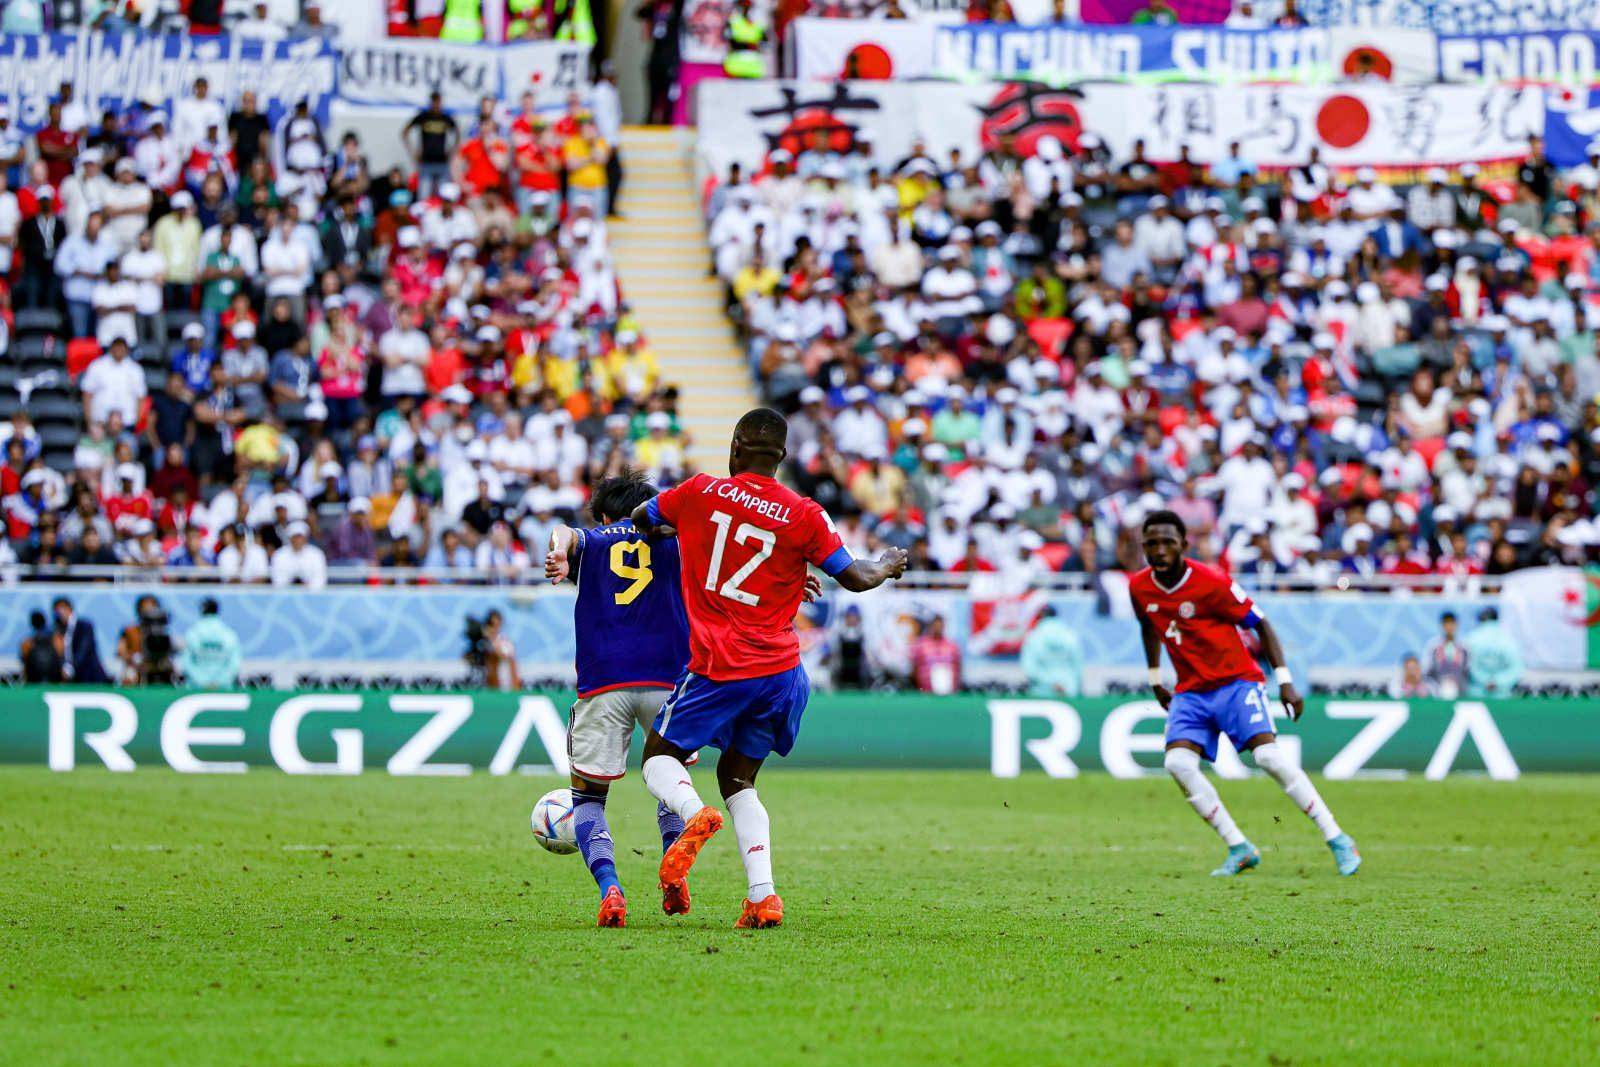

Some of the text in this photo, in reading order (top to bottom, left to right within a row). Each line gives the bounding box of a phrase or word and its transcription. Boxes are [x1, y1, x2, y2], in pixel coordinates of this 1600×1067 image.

[702, 480, 790, 523] J. CAMPBELL
[610, 539, 653, 605] 9
[705, 510, 776, 607] 12
[1165, 620, 1181, 645] 4
[1245, 688, 1262, 711] 4
[43, 693, 570, 775] REGZA
